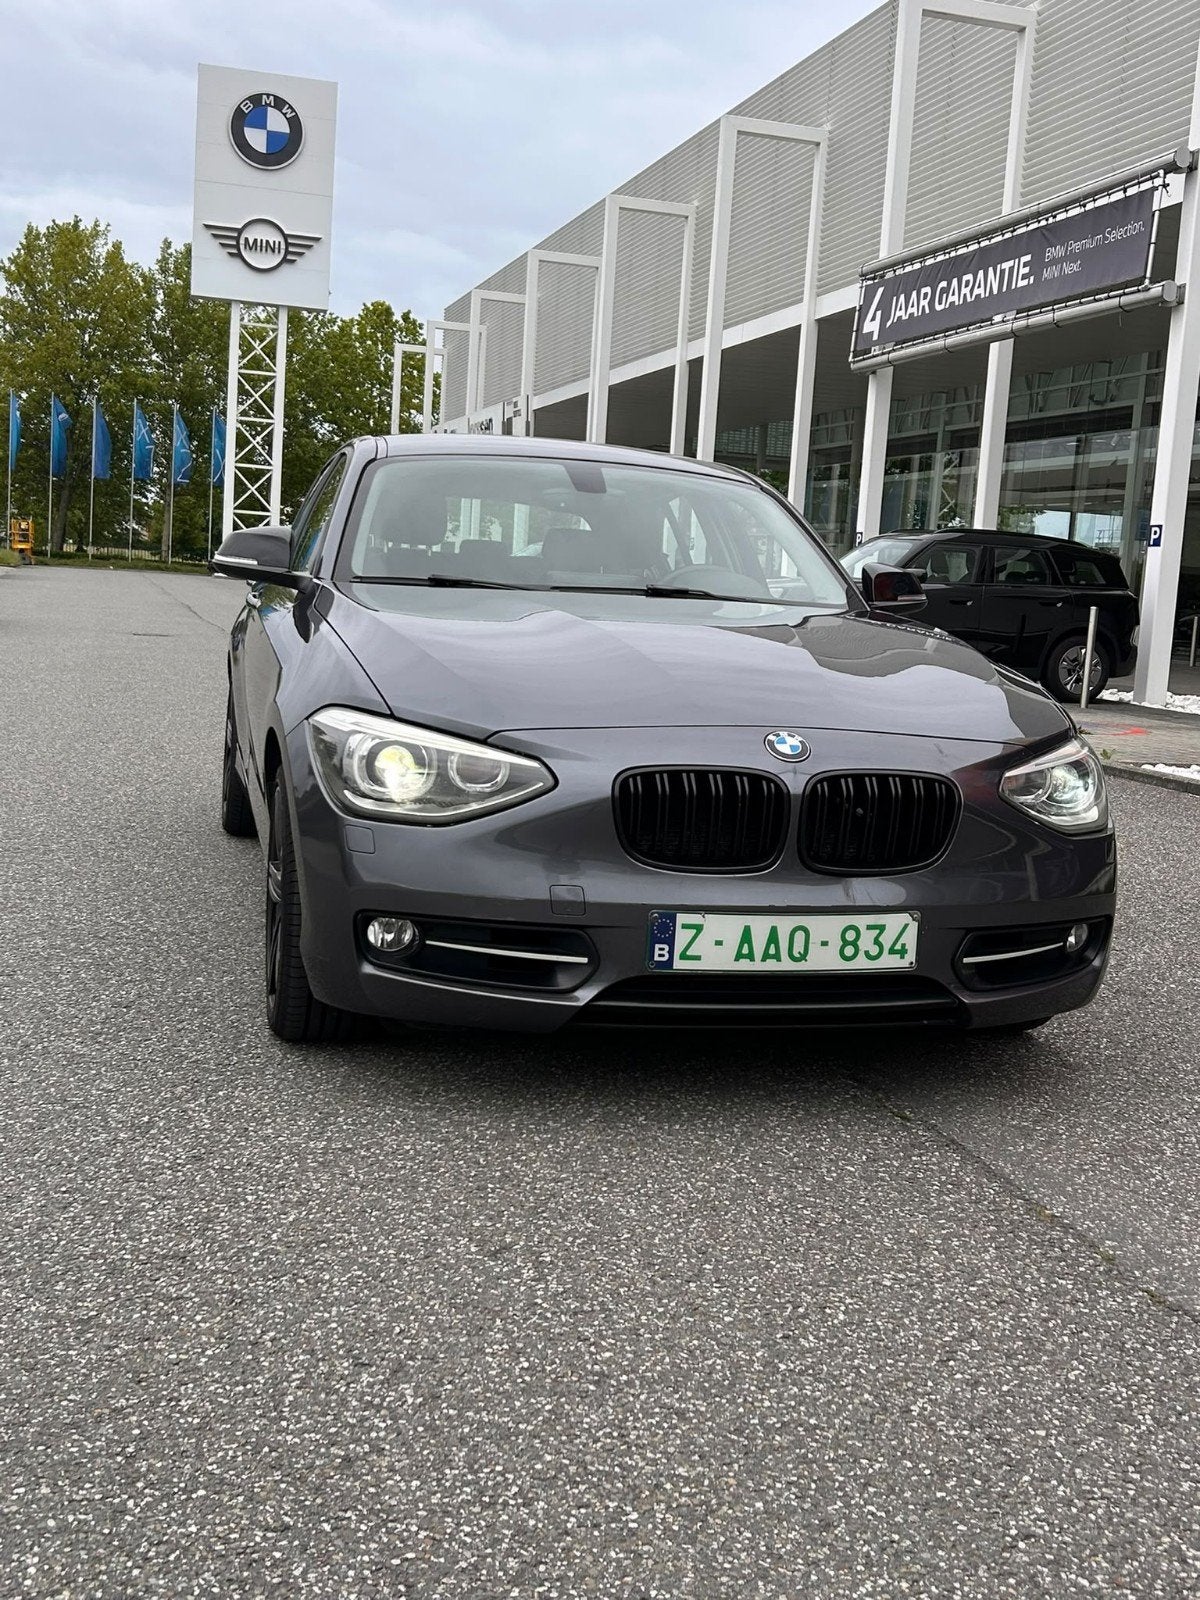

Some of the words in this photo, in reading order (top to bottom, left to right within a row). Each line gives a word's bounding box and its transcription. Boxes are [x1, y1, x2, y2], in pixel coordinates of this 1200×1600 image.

[240, 94, 296, 118] BMW
[243, 236, 282, 255] MINI
[1045, 242, 1067, 262] BMW
[1067, 233, 1103, 255] Premium
[1104, 220, 1145, 244] Selection.
[1042, 263, 1061, 281] MINI
[1061, 260, 1082, 276] Next.
[862, 286, 885, 341] 4
[886, 286, 932, 329] JAAR
[934, 253, 1035, 312] GARANTIE.
[856, 533, 862, 546] P
[1150, 526, 1160, 545] P
[653, 943, 669, 962] B
[678, 923, 910, 963] Z-AAQ-834
